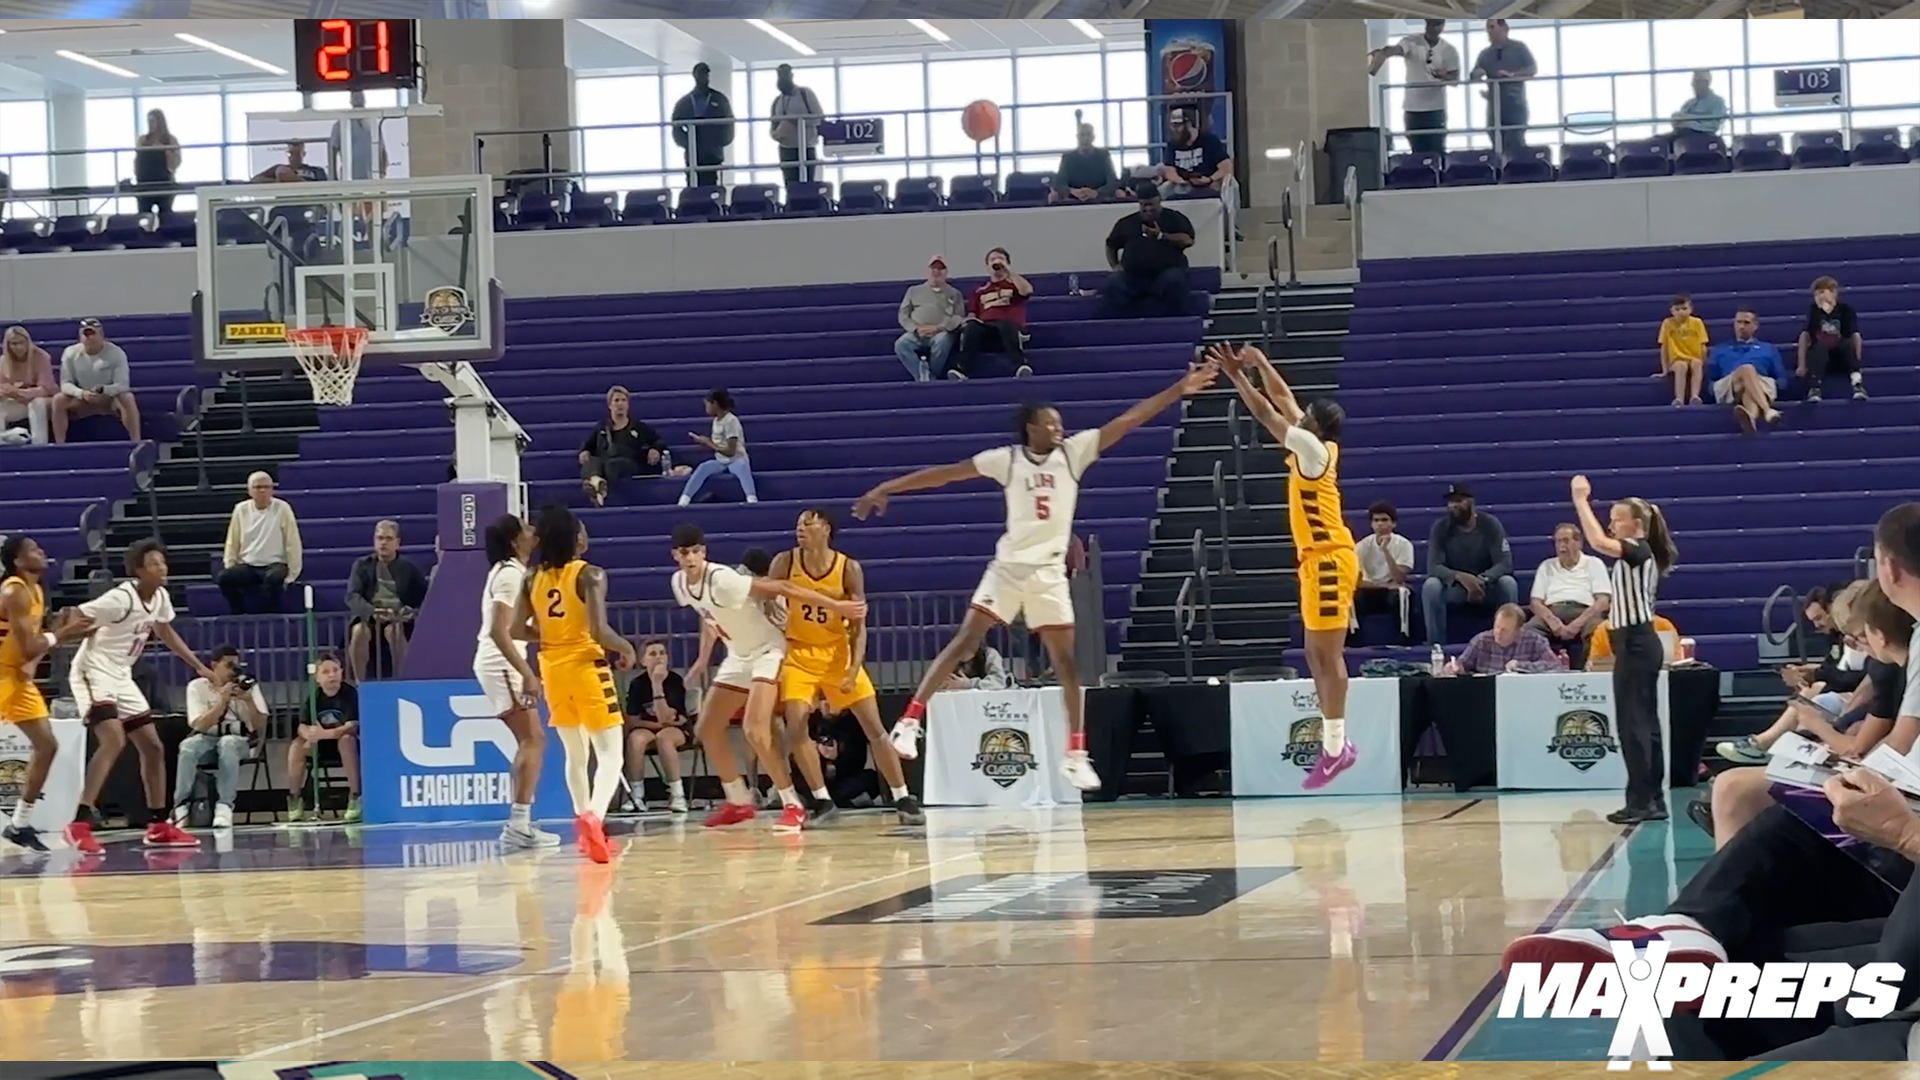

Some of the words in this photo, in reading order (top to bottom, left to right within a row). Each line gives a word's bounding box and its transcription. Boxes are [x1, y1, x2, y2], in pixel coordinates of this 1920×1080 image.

[317, 20, 389, 81] 21
[1798, 71, 1830, 89] 103
[845, 122, 874, 139] 102
[229, 326, 282, 336] PANINI
[1036, 495, 1050, 521] 5
[547, 588, 565, 618] 2
[801, 604, 827, 624] 25
[1562, 747, 1602, 758] CLASSIC
[986, 763, 1024, 775] CLASSIC
